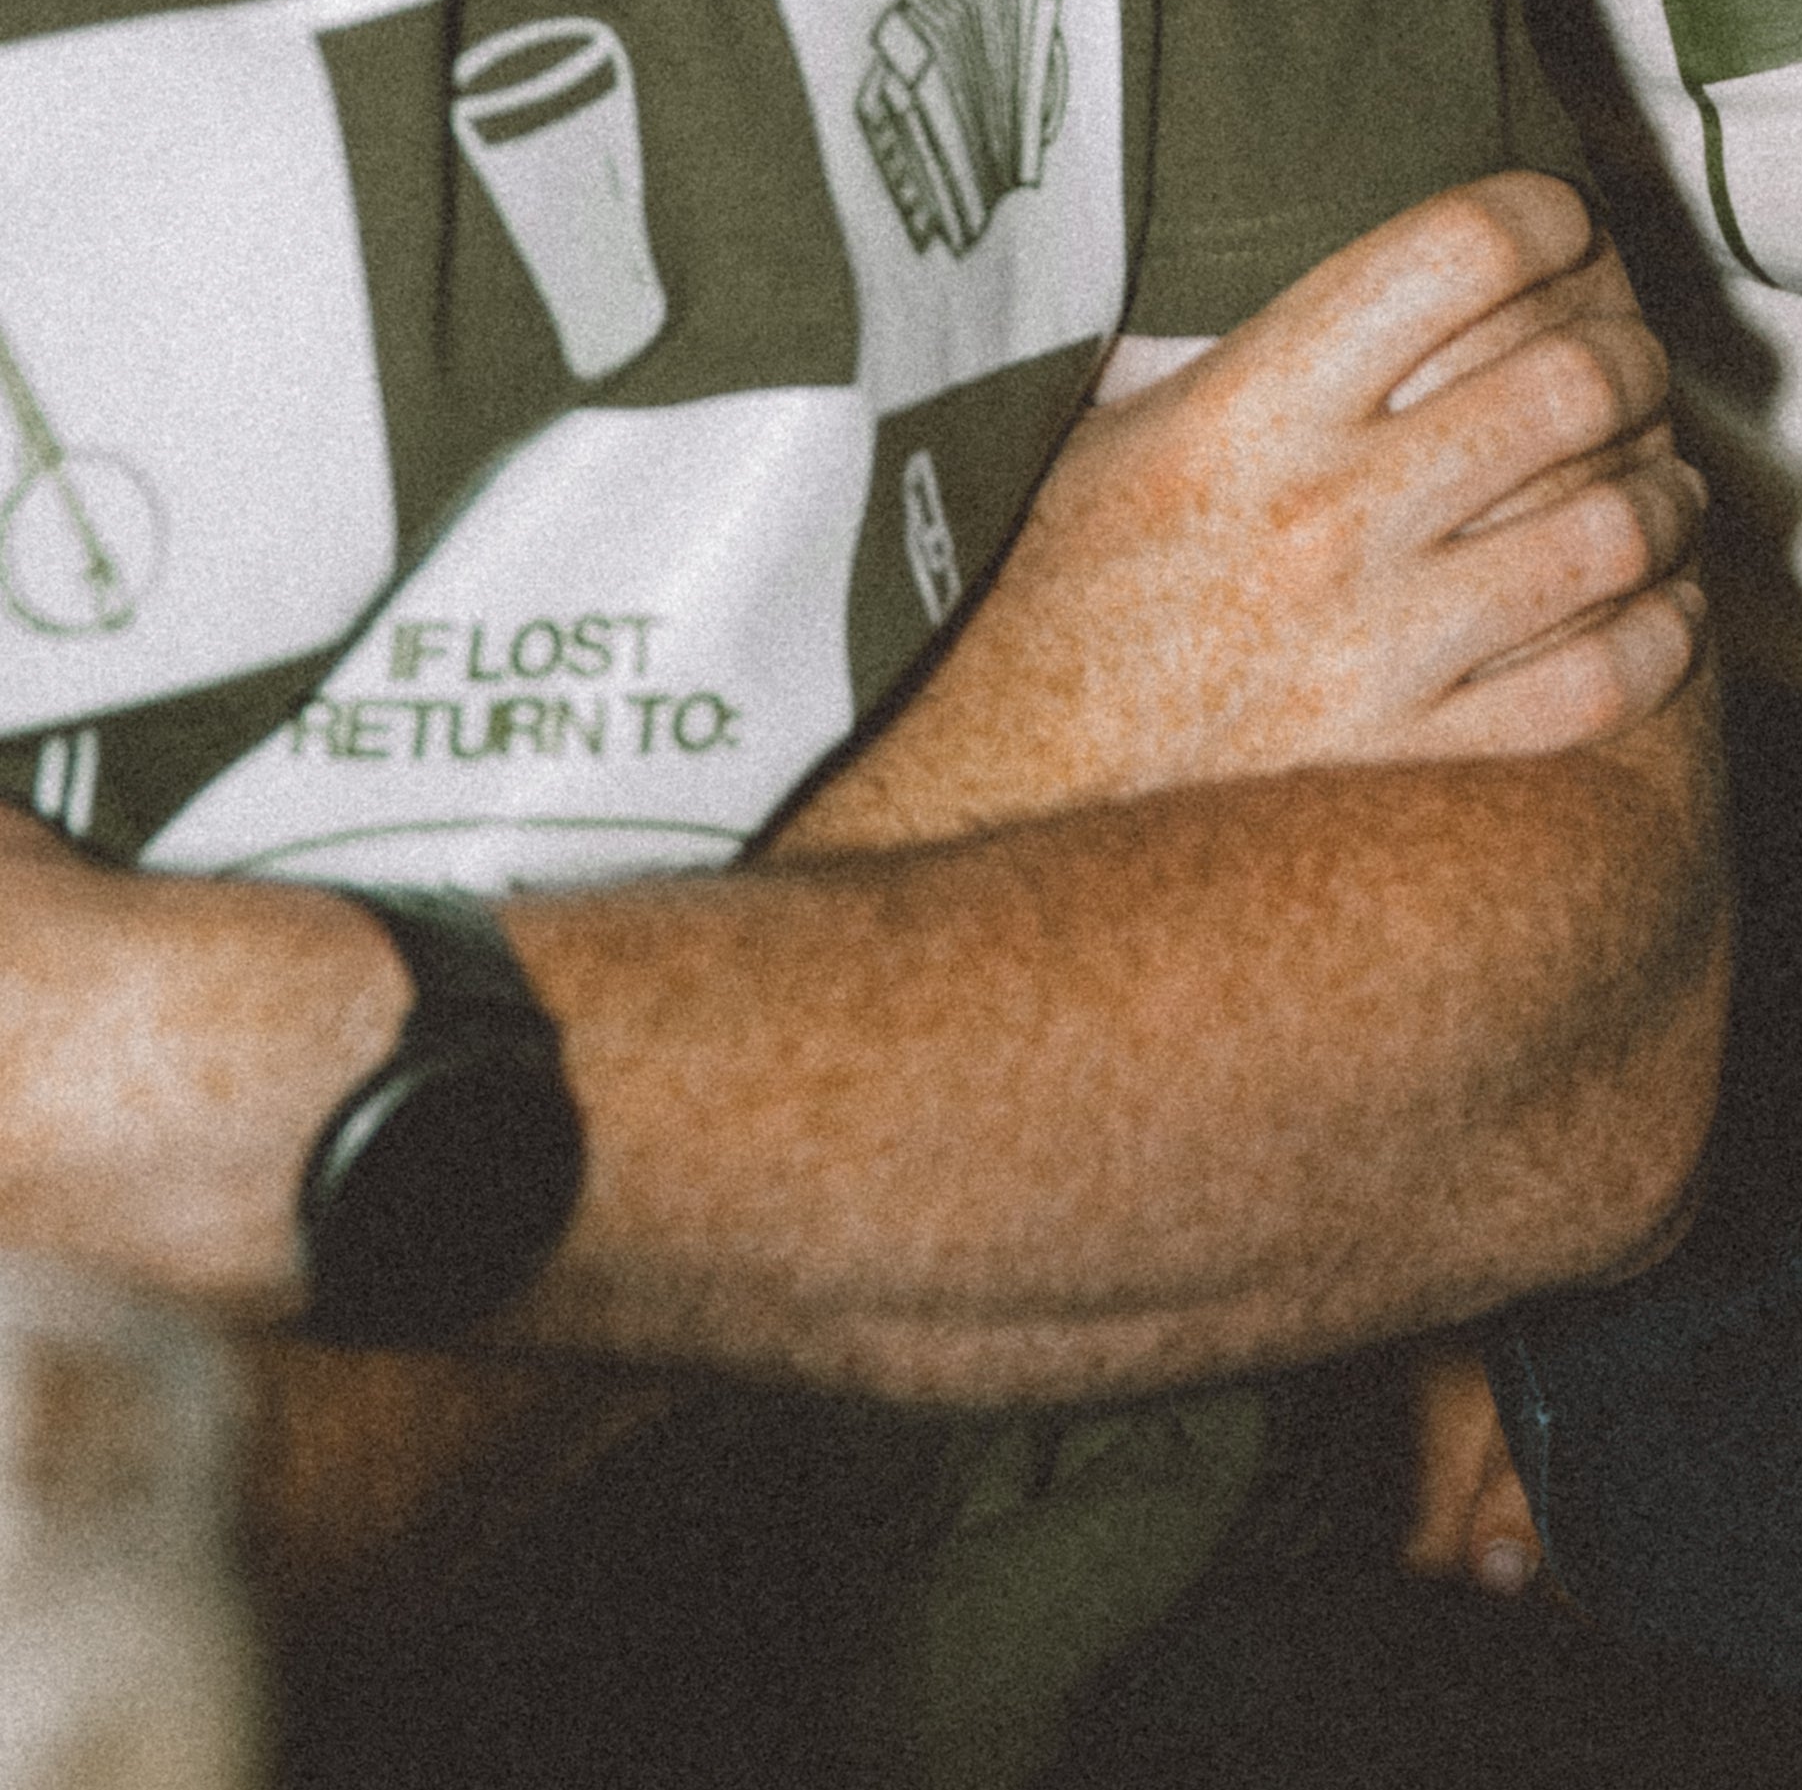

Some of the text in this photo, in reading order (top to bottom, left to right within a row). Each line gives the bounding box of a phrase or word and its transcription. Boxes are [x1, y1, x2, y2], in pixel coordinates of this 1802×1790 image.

[388, 612, 657, 682] IF LOST
[293, 690, 743, 761] RETURN TO:
